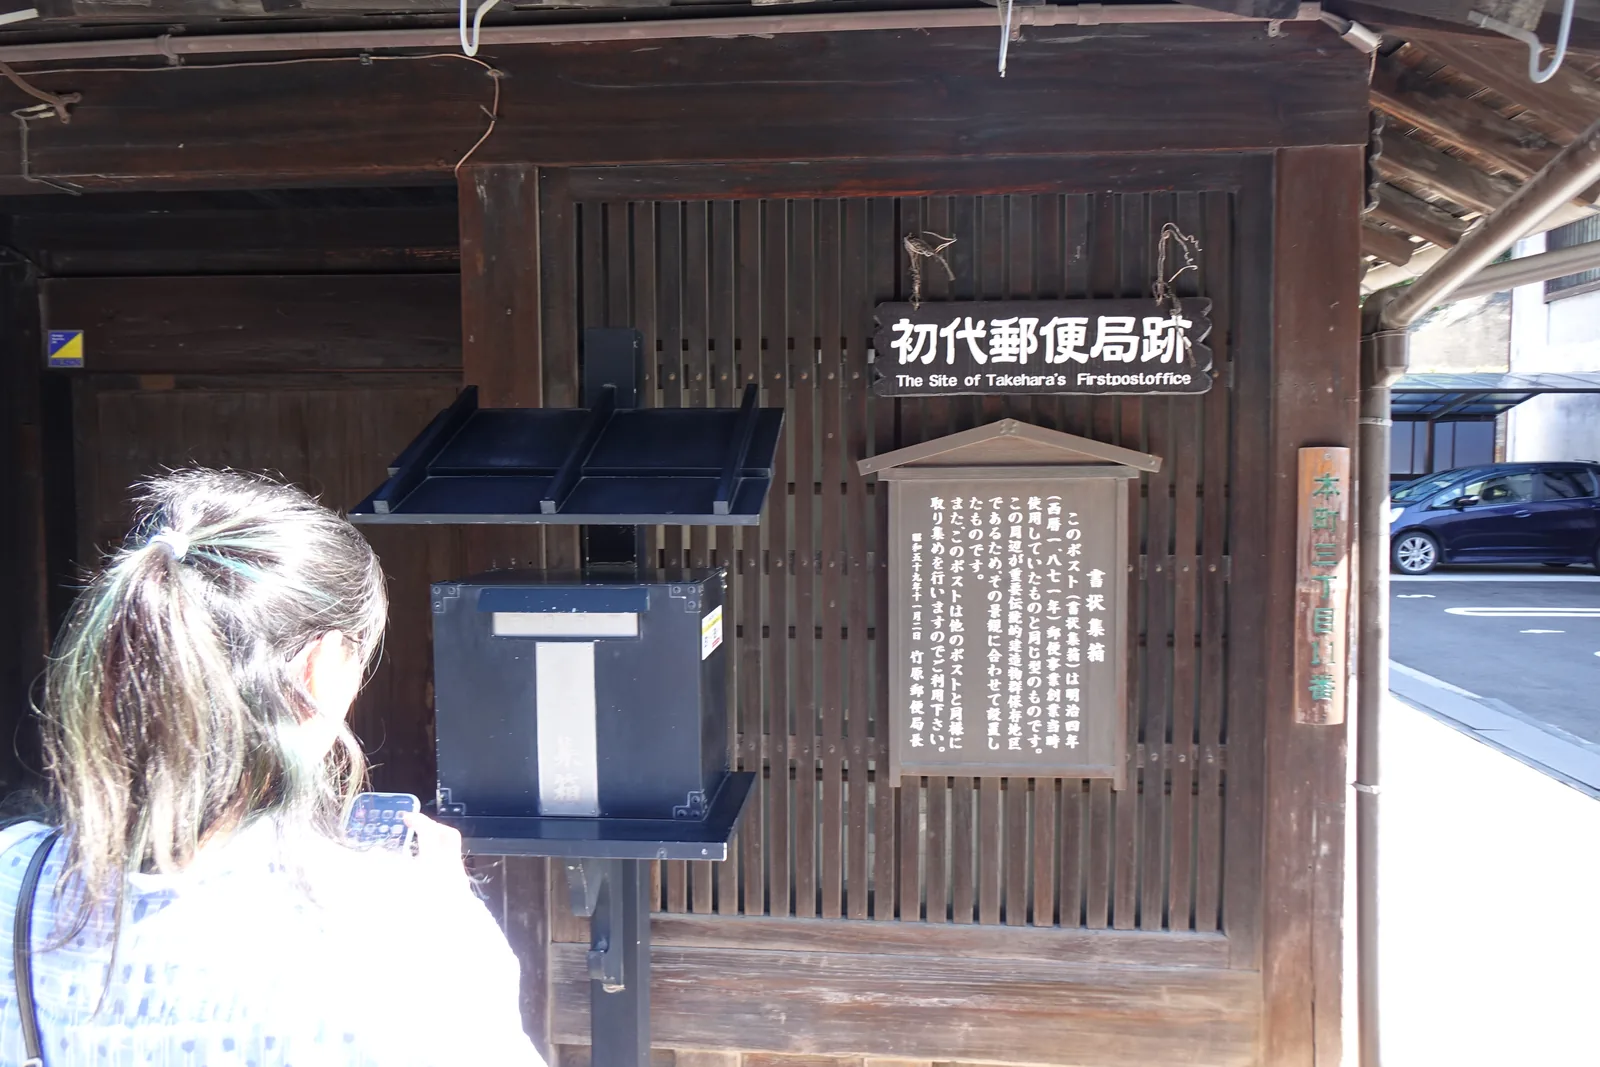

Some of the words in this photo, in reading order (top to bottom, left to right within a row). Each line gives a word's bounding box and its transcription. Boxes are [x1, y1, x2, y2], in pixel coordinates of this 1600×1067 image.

[891, 315, 1193, 365] 初代郵便局跡
[896, 373, 923, 388] The
[929, 373, 957, 388] Site
[964, 372, 981, 387] of
[986, 372, 1067, 388] Takehara's
[1077, 372, 1191, 387] Firstpostoffice
[968, 496, 985, 581] たものです。
[1086, 568, 1106, 663] 書状集箱
[909, 649, 925, 749] 竹原郵便局長
